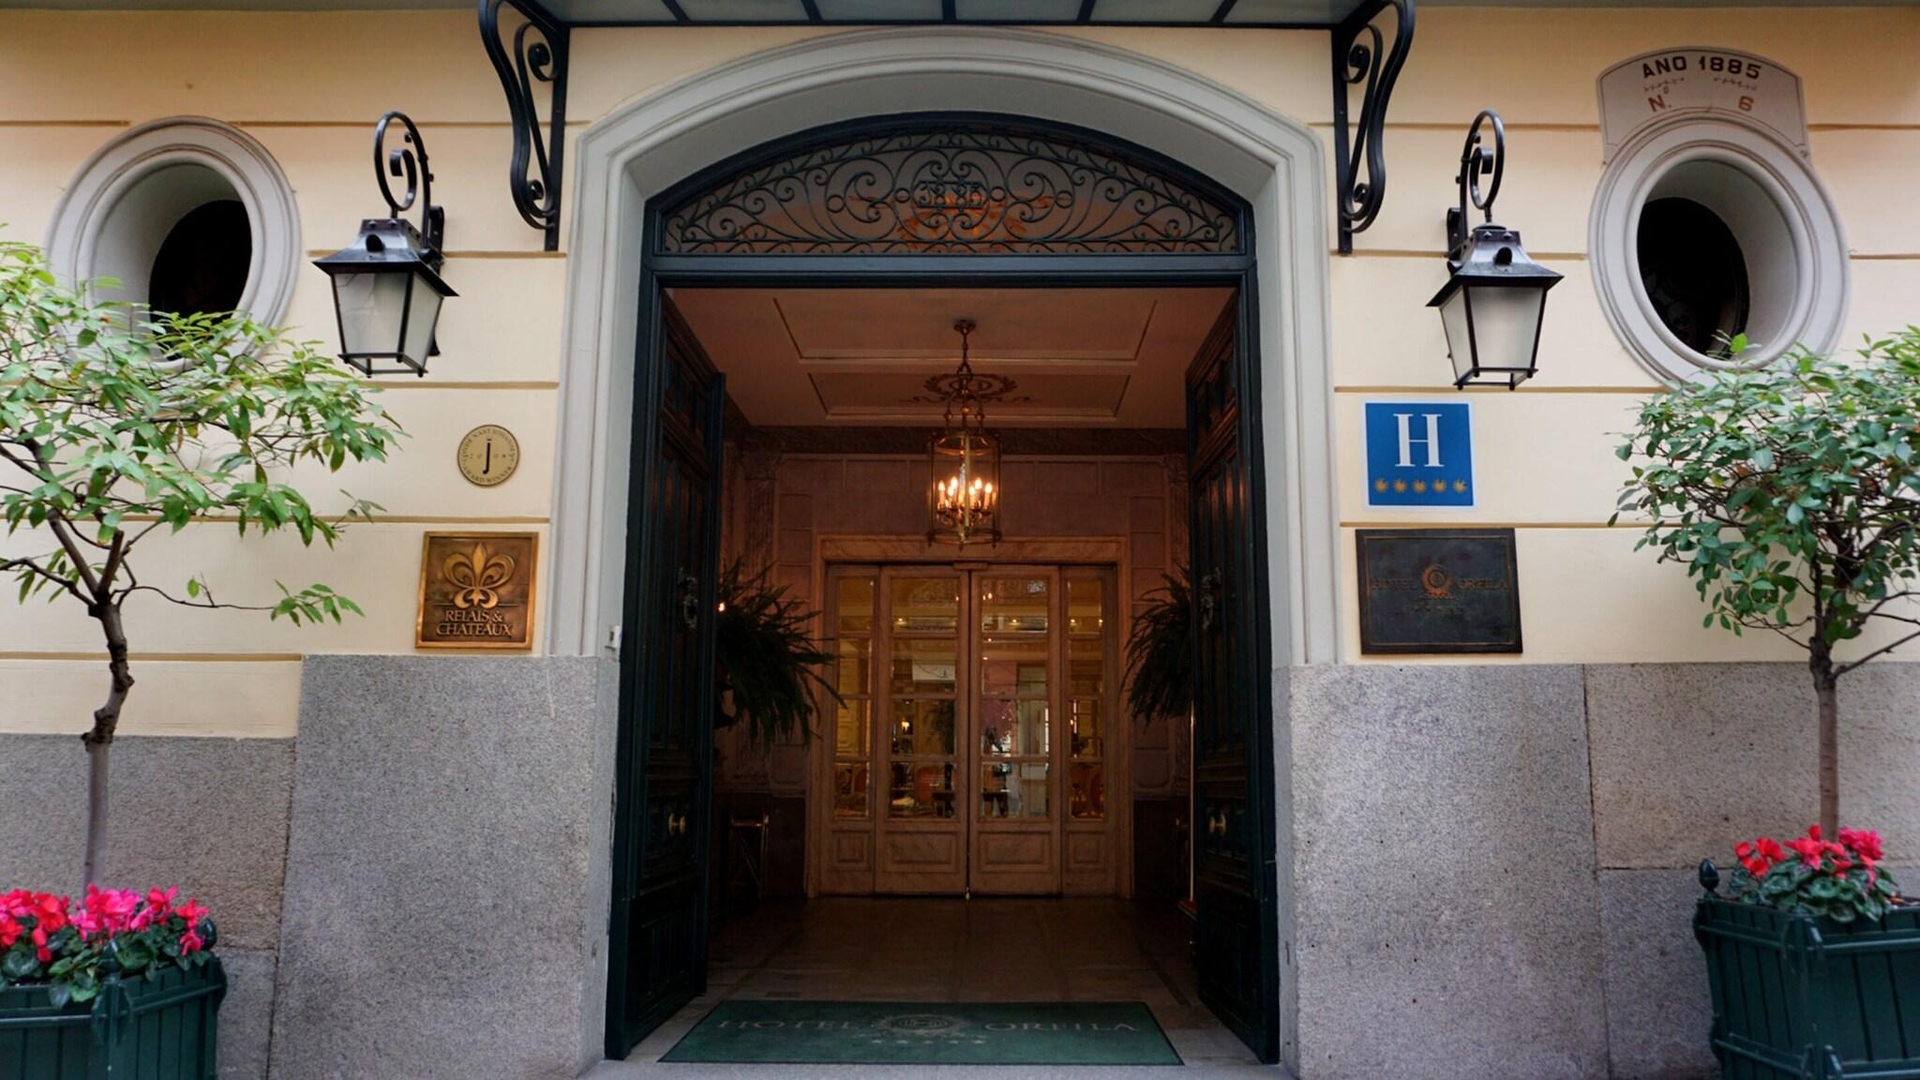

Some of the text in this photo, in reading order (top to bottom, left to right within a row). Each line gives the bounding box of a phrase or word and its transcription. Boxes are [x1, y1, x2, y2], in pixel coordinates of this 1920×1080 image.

[1698, 55, 1762, 80] 1885
[1738, 95, 1755, 112] 6
[1393, 413, 1444, 467] H
[445, 609, 490, 622] RELAIS
[435, 622, 513, 637] CHATEAUX
[717, 1020, 859, 1030] HOTEL
